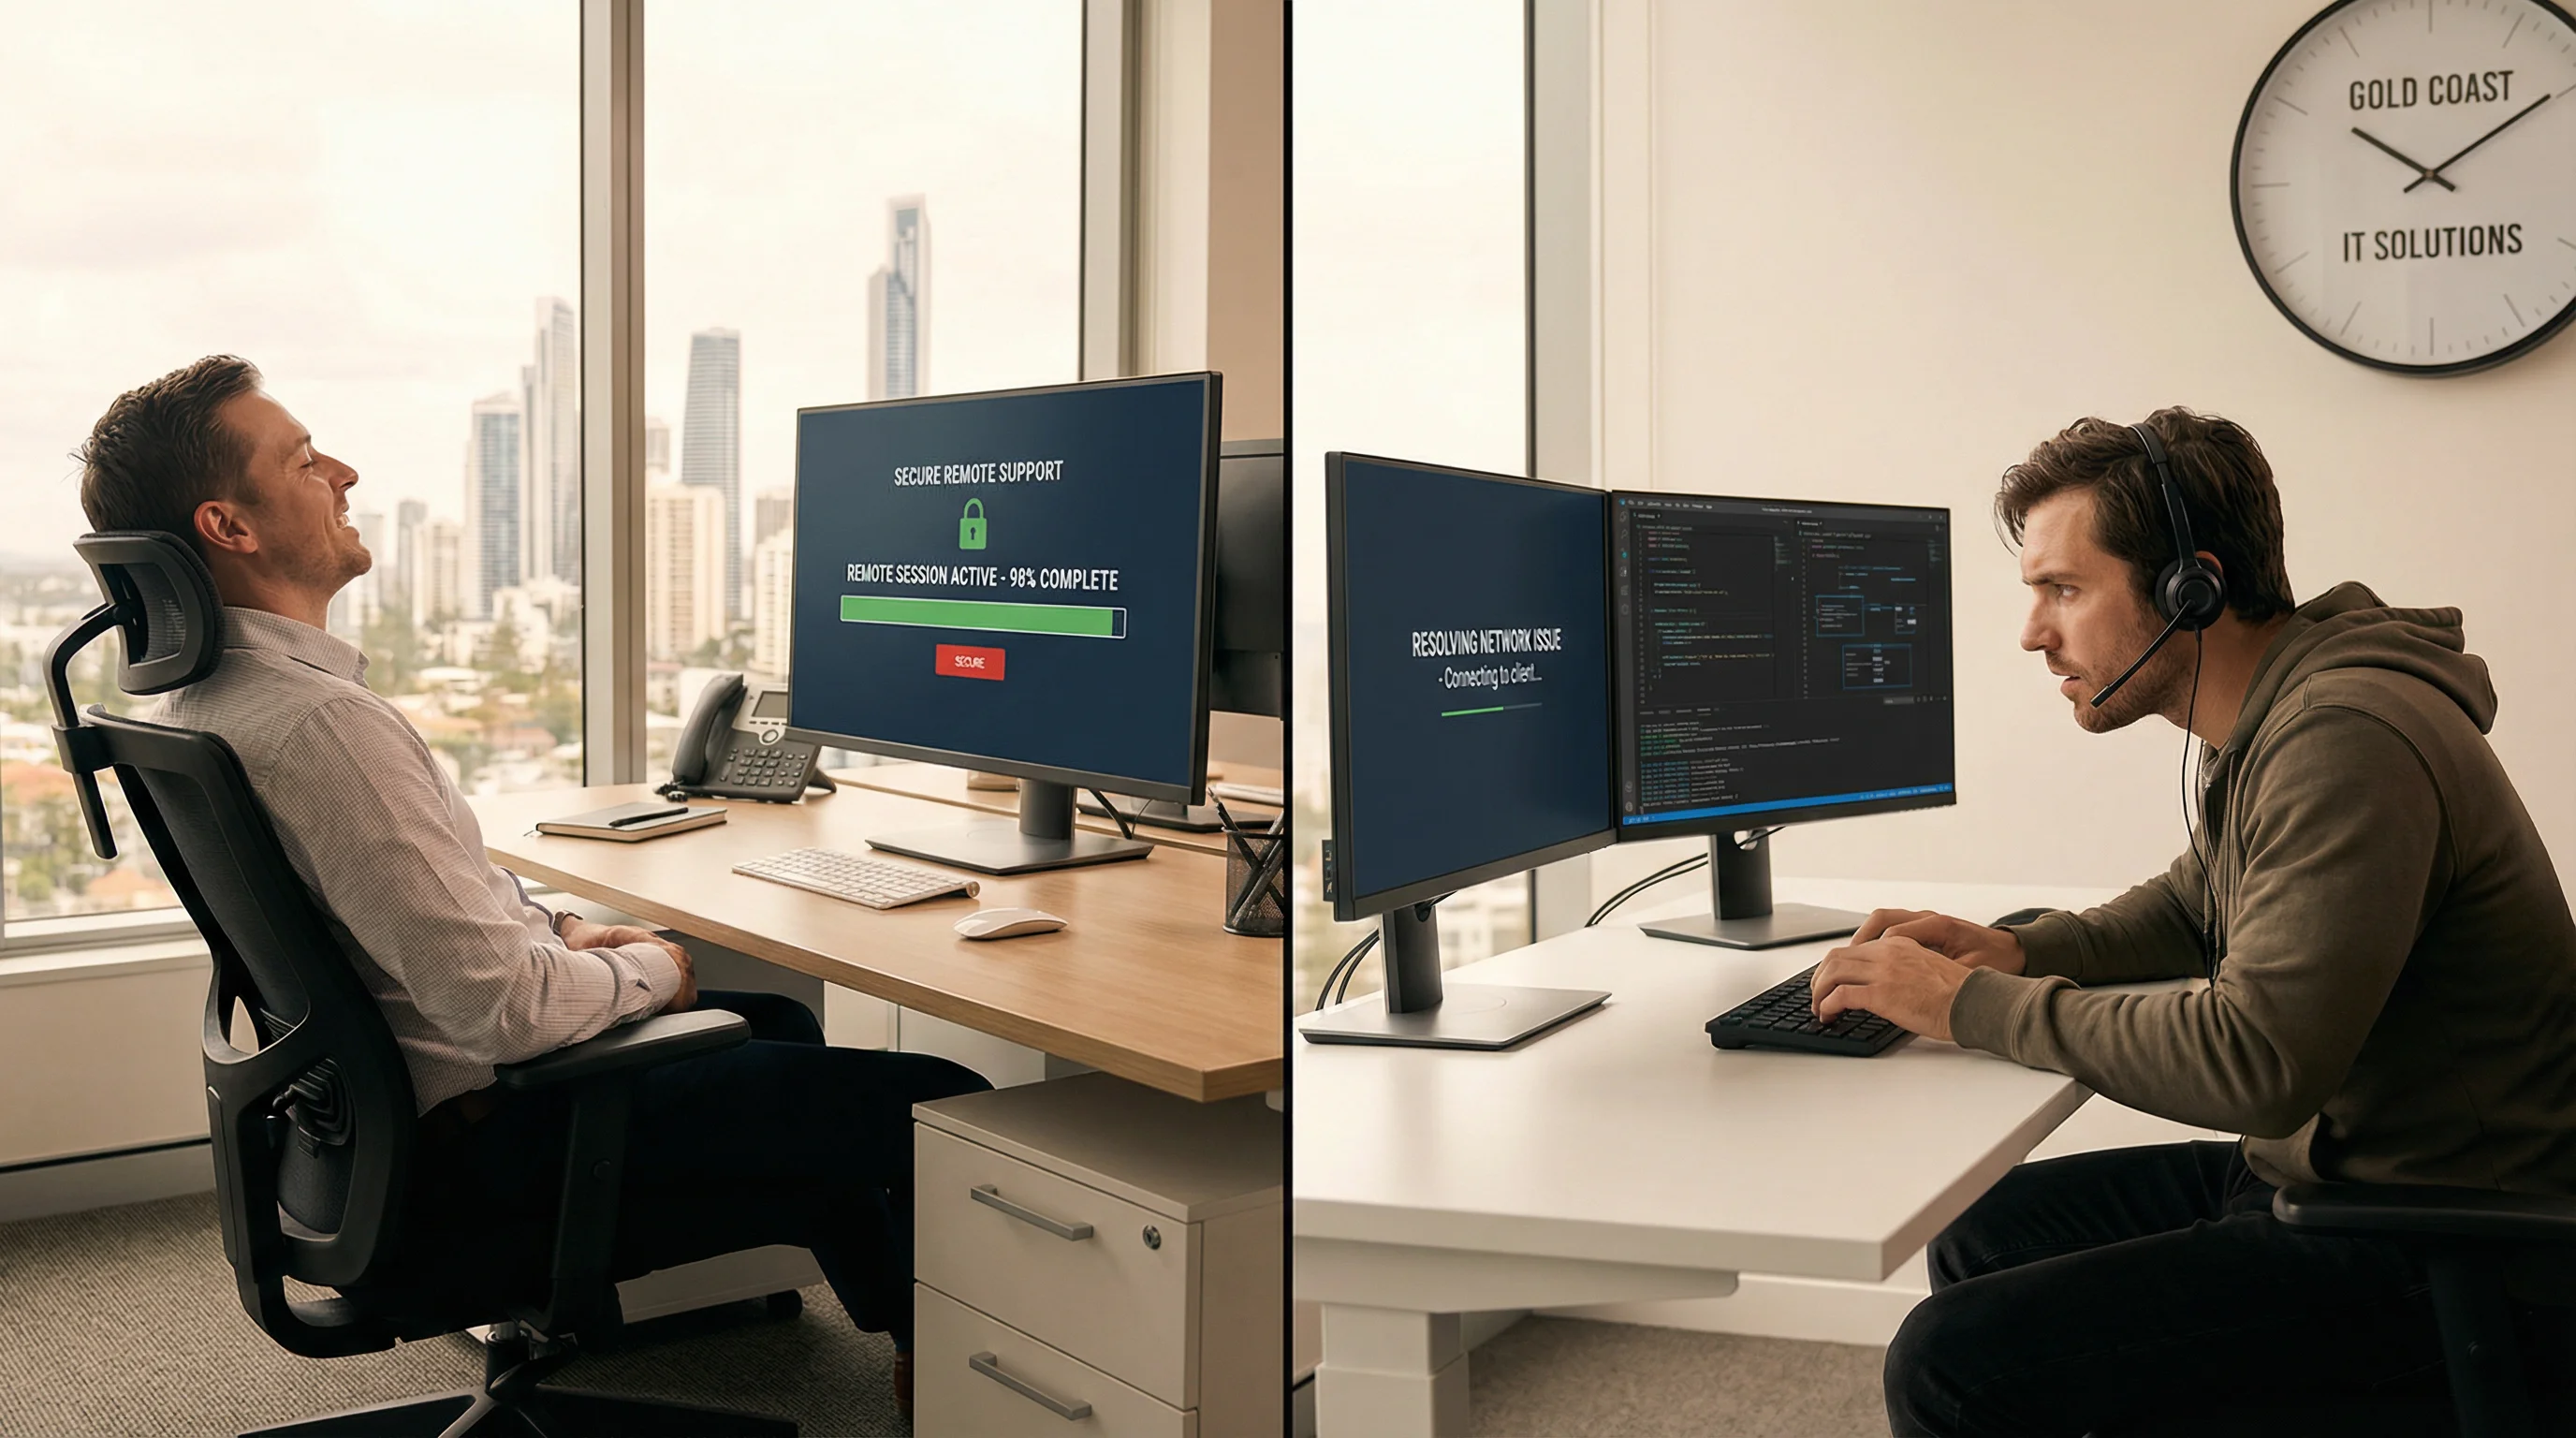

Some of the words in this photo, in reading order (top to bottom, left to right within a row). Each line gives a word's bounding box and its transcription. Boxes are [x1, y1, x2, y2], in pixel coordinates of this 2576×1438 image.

[2349, 78, 2418, 110] GOLD
[2428, 70, 2514, 106] COAST
[2343, 231, 2365, 262] IT
[2374, 223, 2523, 260] SOLUTIONS
[894, 465, 941, 486] SECURE
[944, 462, 996, 484] REMOTE
[999, 460, 1064, 482] SUPPORT
[847, 564, 893, 583] REMOTE
[895, 565, 948, 585] SESSION
[951, 565, 997, 587] ACTIVE
[1010, 567, 1036, 588] 98%
[1040, 568, 1119, 591] COMPLETE
[1412, 629, 1478, 656] RESOLVING
[1480, 629, 1532, 654] NETWORK
[1533, 628, 1561, 652] ISSUE
[955, 655, 986, 669] SECURE
[1444, 664, 1499, 690] Connecting
